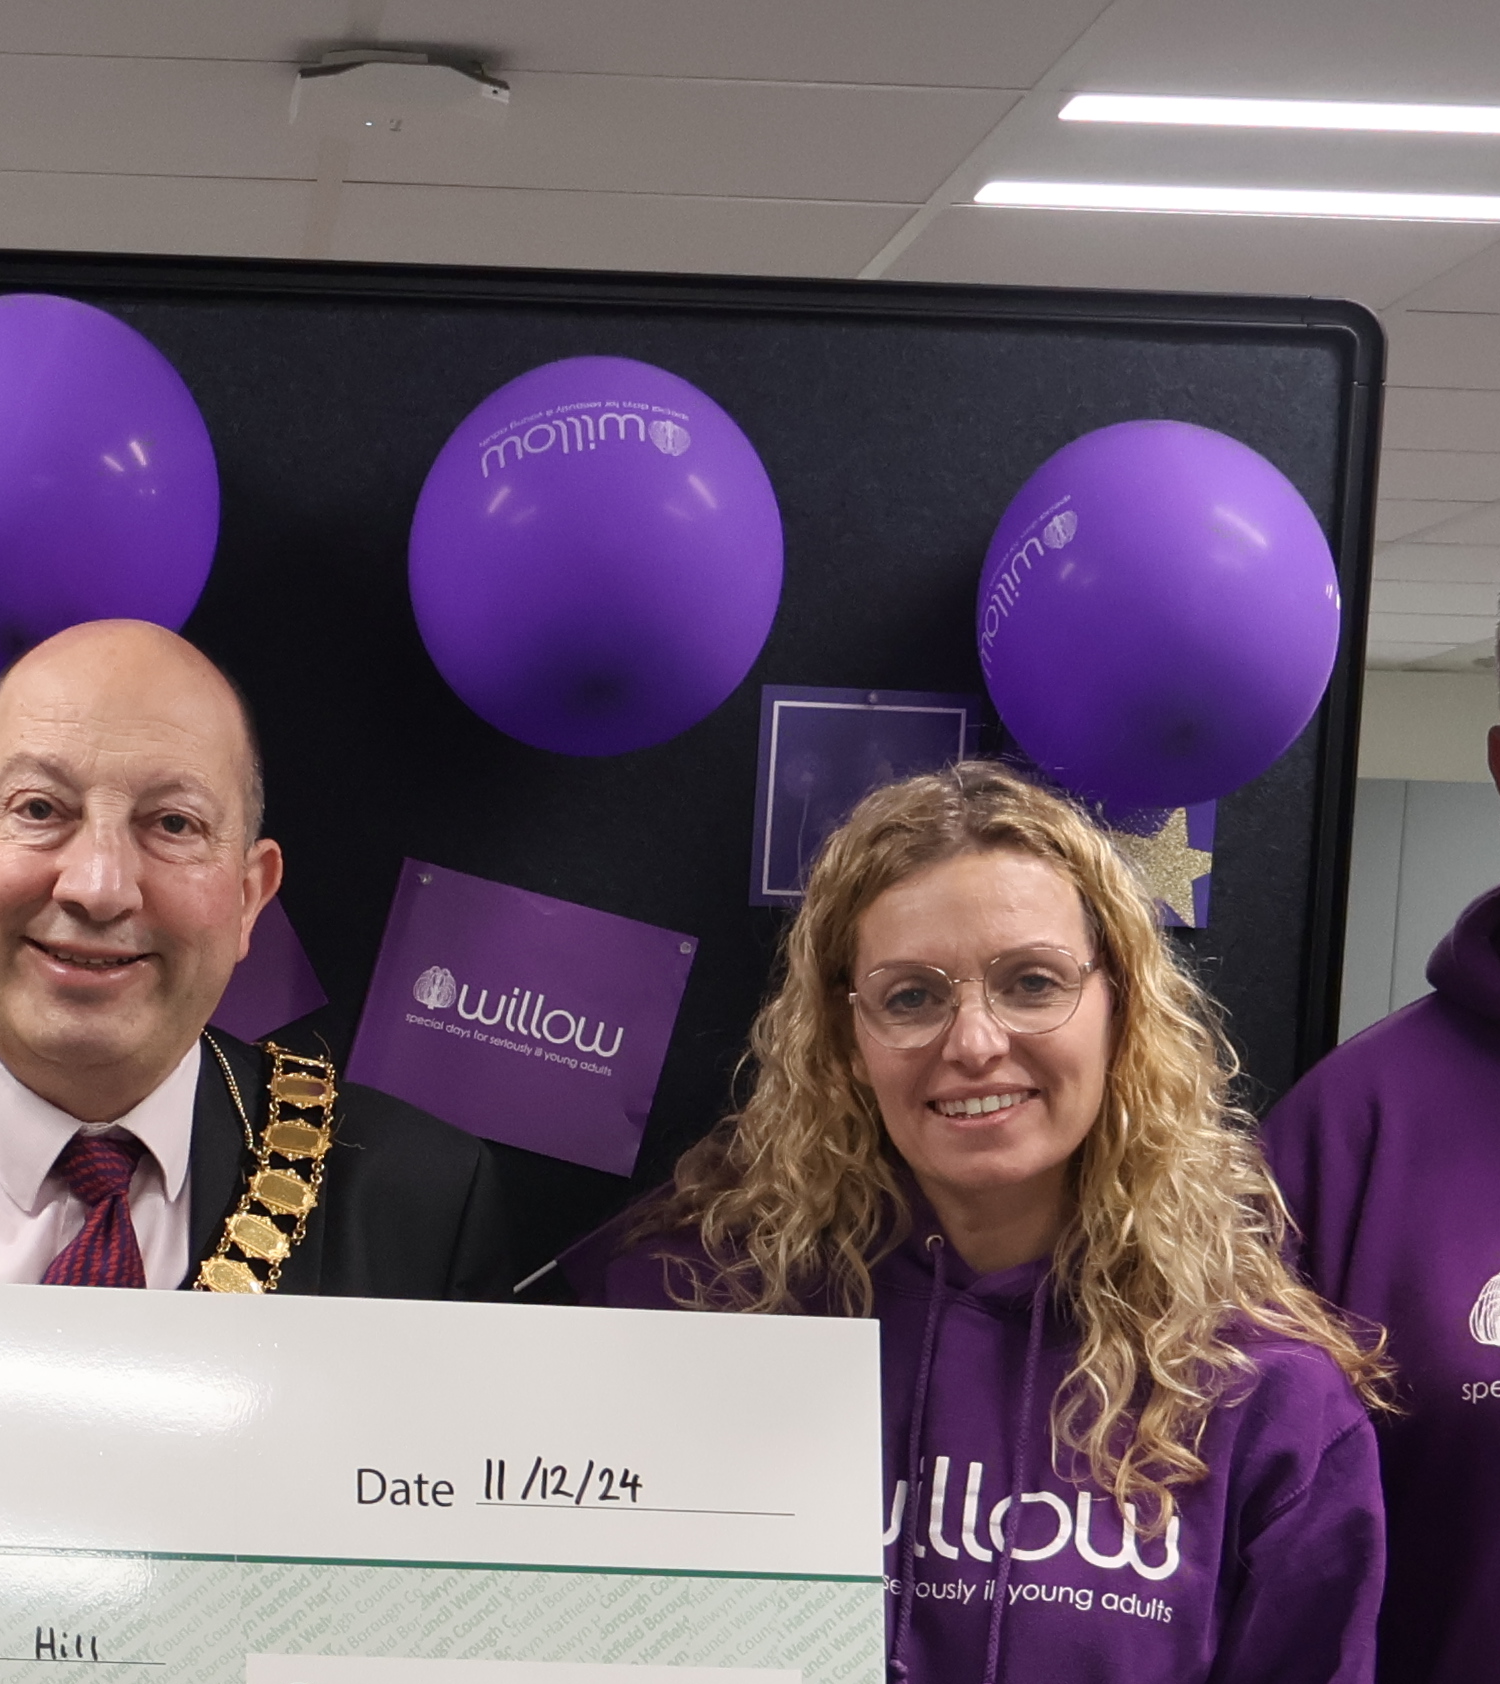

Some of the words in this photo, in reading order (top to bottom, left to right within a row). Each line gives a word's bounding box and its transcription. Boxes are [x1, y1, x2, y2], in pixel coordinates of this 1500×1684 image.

[481, 412, 645, 478] willow
[405, 1012, 444, 1030] special
[445, 1023, 471, 1038] days
[473, 1029, 488, 1042] for
[490, 1035, 533, 1056] seriously
[544, 1050, 578, 1070] young
[580, 1060, 612, 1077] adults
[457, 984, 624, 1058] willow
[357, 1468, 455, 1508] Date
[1008, 1583, 1094, 1611] young
[1101, 1590, 1174, 1624] adults
[35, 1626, 99, 1661] Hill
